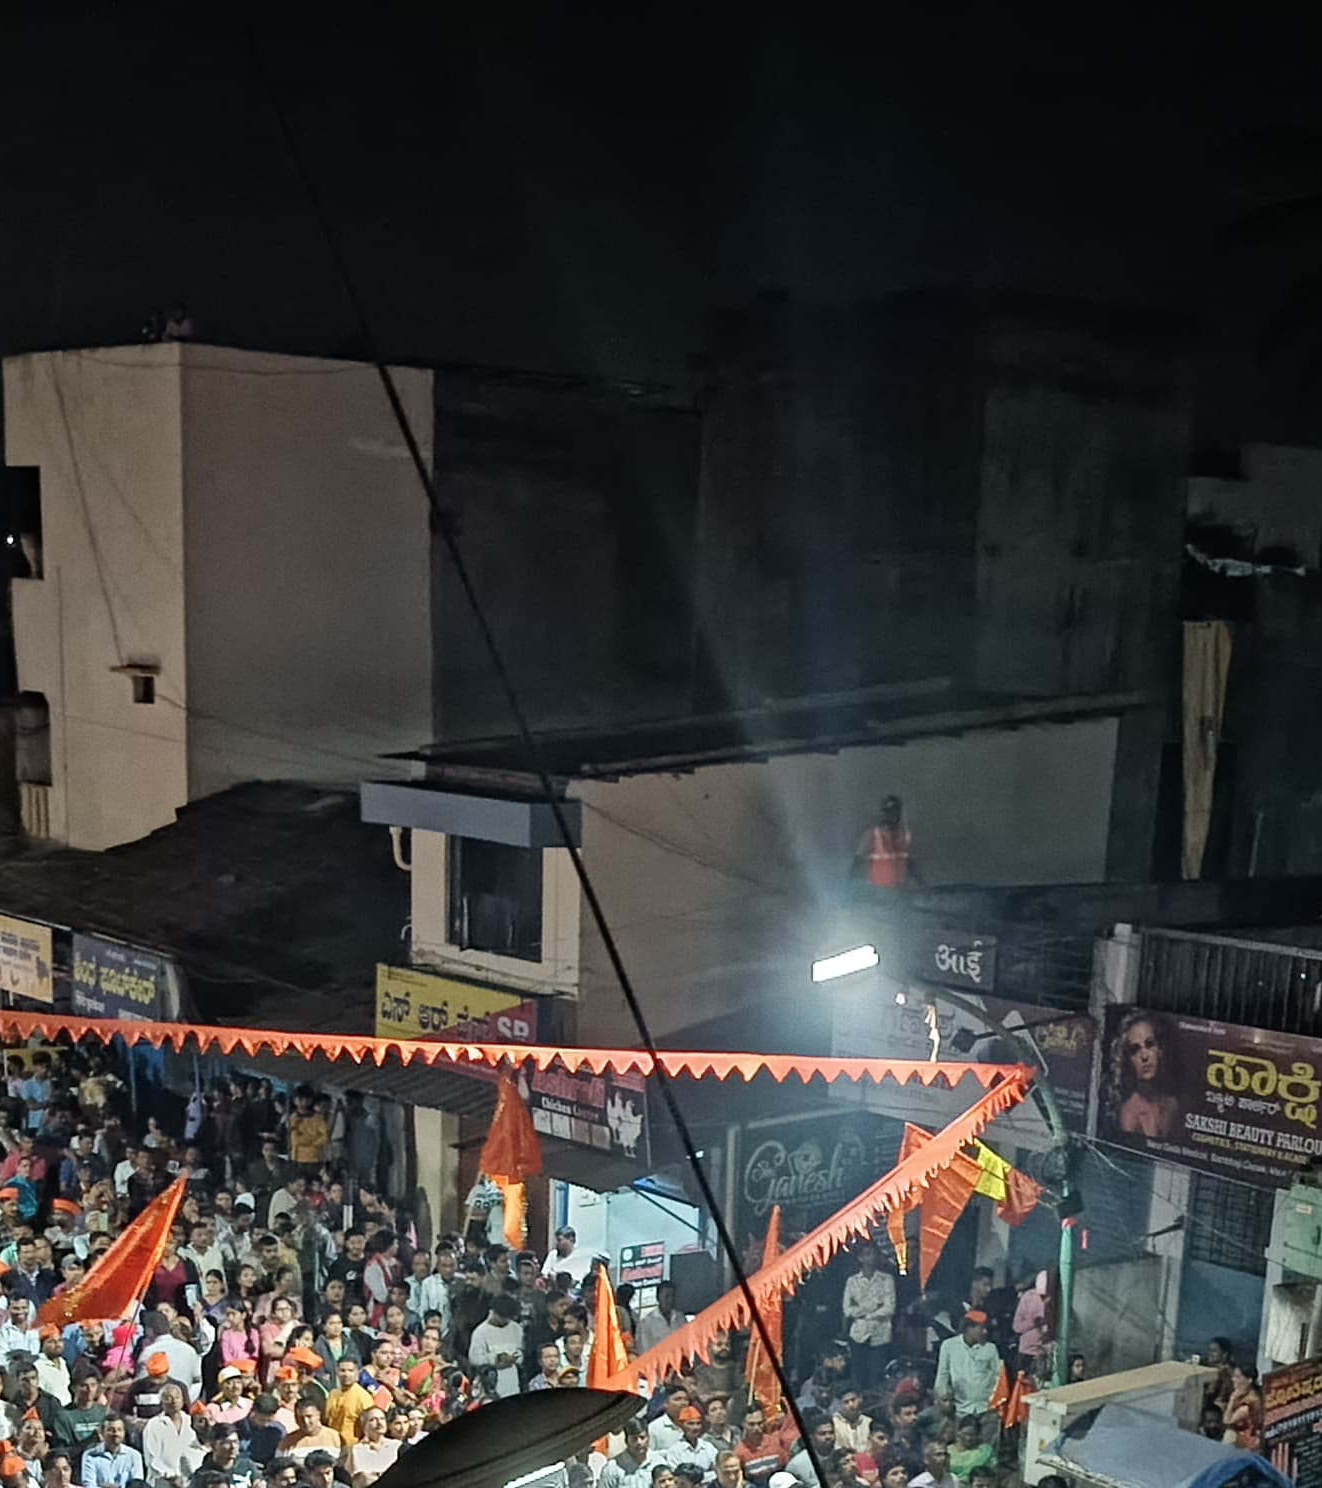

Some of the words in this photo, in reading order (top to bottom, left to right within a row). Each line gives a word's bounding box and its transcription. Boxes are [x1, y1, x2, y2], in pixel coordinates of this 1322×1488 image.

[935, 939, 982, 983] आई
[1206, 1049, 1322, 1130] ಸಾಕ್ಷಿ
[1185, 1112, 1227, 1137] SAKSHI
[1228, 1122, 1276, 1147] BEAUTY
[744, 1140, 845, 1216] Ganesh
